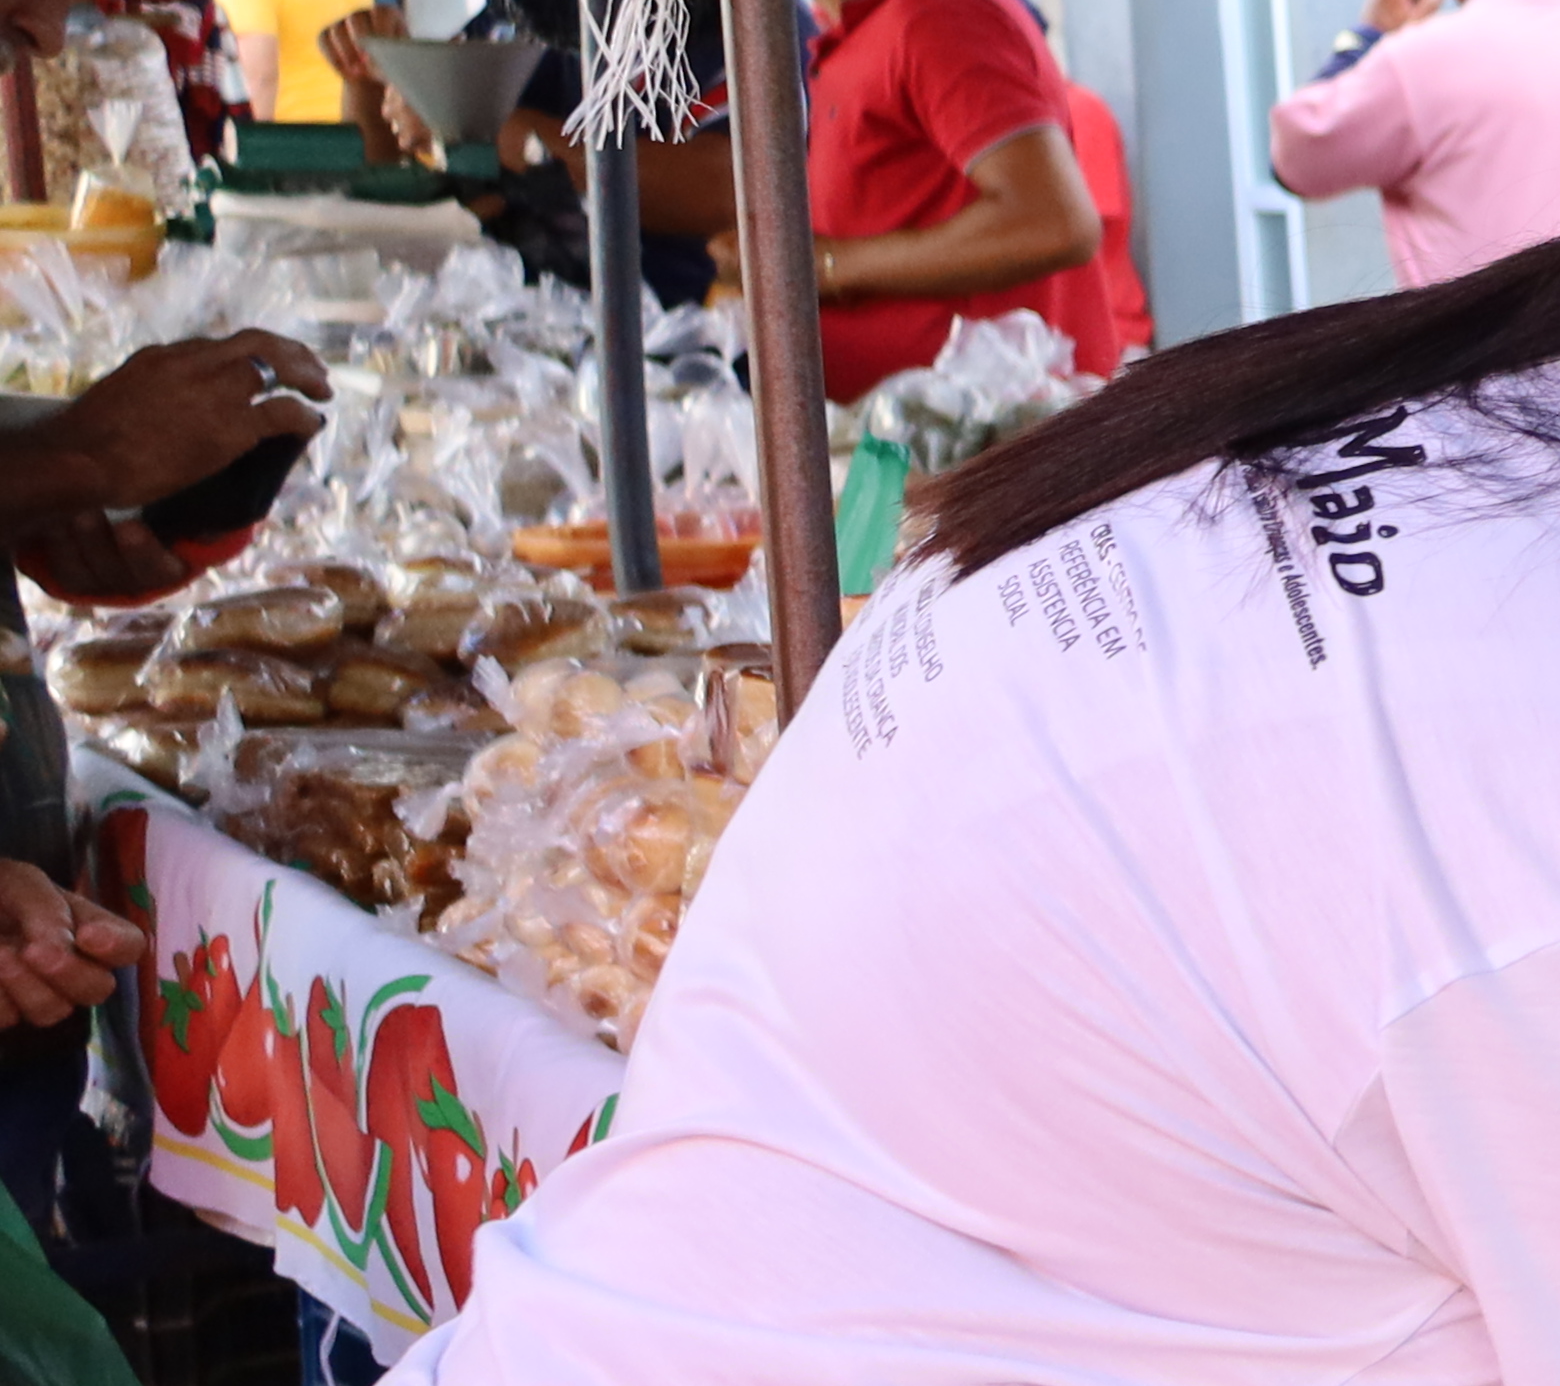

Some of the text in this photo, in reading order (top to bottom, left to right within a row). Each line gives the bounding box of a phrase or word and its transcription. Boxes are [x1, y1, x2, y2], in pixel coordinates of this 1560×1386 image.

[1090, 523, 1118, 560] CRAS
[998, 574, 1030, 628] SOCIAL
[1027, 558, 1082, 654] ASSISTENCIA
[1059, 539, 1127, 661] REFERÊNCIA EM
[1281, 574, 1327, 671] Adolescentes.
